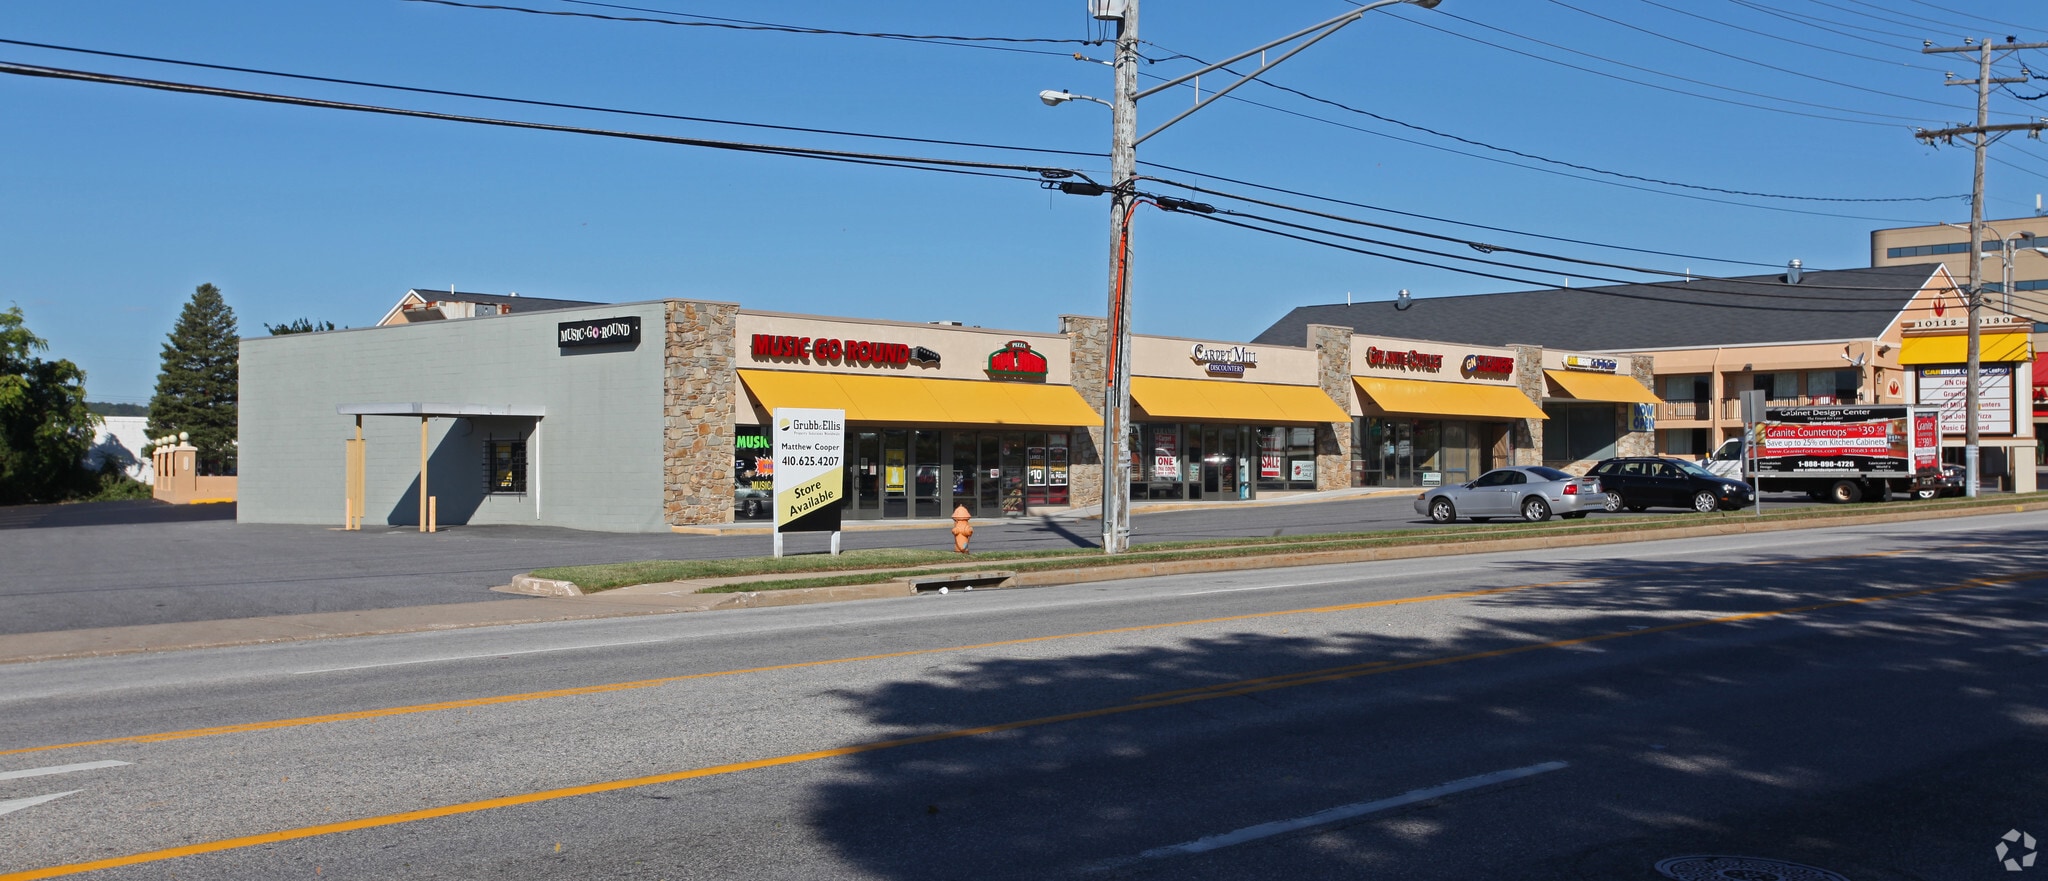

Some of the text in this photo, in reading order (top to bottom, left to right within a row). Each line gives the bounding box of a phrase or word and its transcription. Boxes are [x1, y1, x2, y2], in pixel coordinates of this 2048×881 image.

[754, 334, 909, 364] MUSIC GO ROUND
[1194, 344, 1258, 363] CARPET MILL
[1210, 364, 1243, 373] DISCOUNTERS
[1466, 357, 1476, 370] GN
[1633, 403, 1654, 417] NOW
[1780, 408, 1871, 417] Cabinet Design Center
[1633, 416, 1655, 430] OPEN
[1767, 427, 1796, 438] Granite
[1797, 427, 1847, 439] Countertops
[781, 442, 840, 452] Matthew Cooper
[1766, 439, 1783, 447] Save
[1784, 440, 1793, 449] up
[1829, 438, 1855, 446] Kitchen
[1855, 438, 1885, 446] Cabinets
[781, 455, 840, 466] 410.625.4207
[1157, 456, 1174, 466] ONE
[1262, 453, 1280, 469] SALE
[1030, 469, 1042, 480] $10
[794, 481, 822, 499] Store
[790, 490, 834, 517] Available
